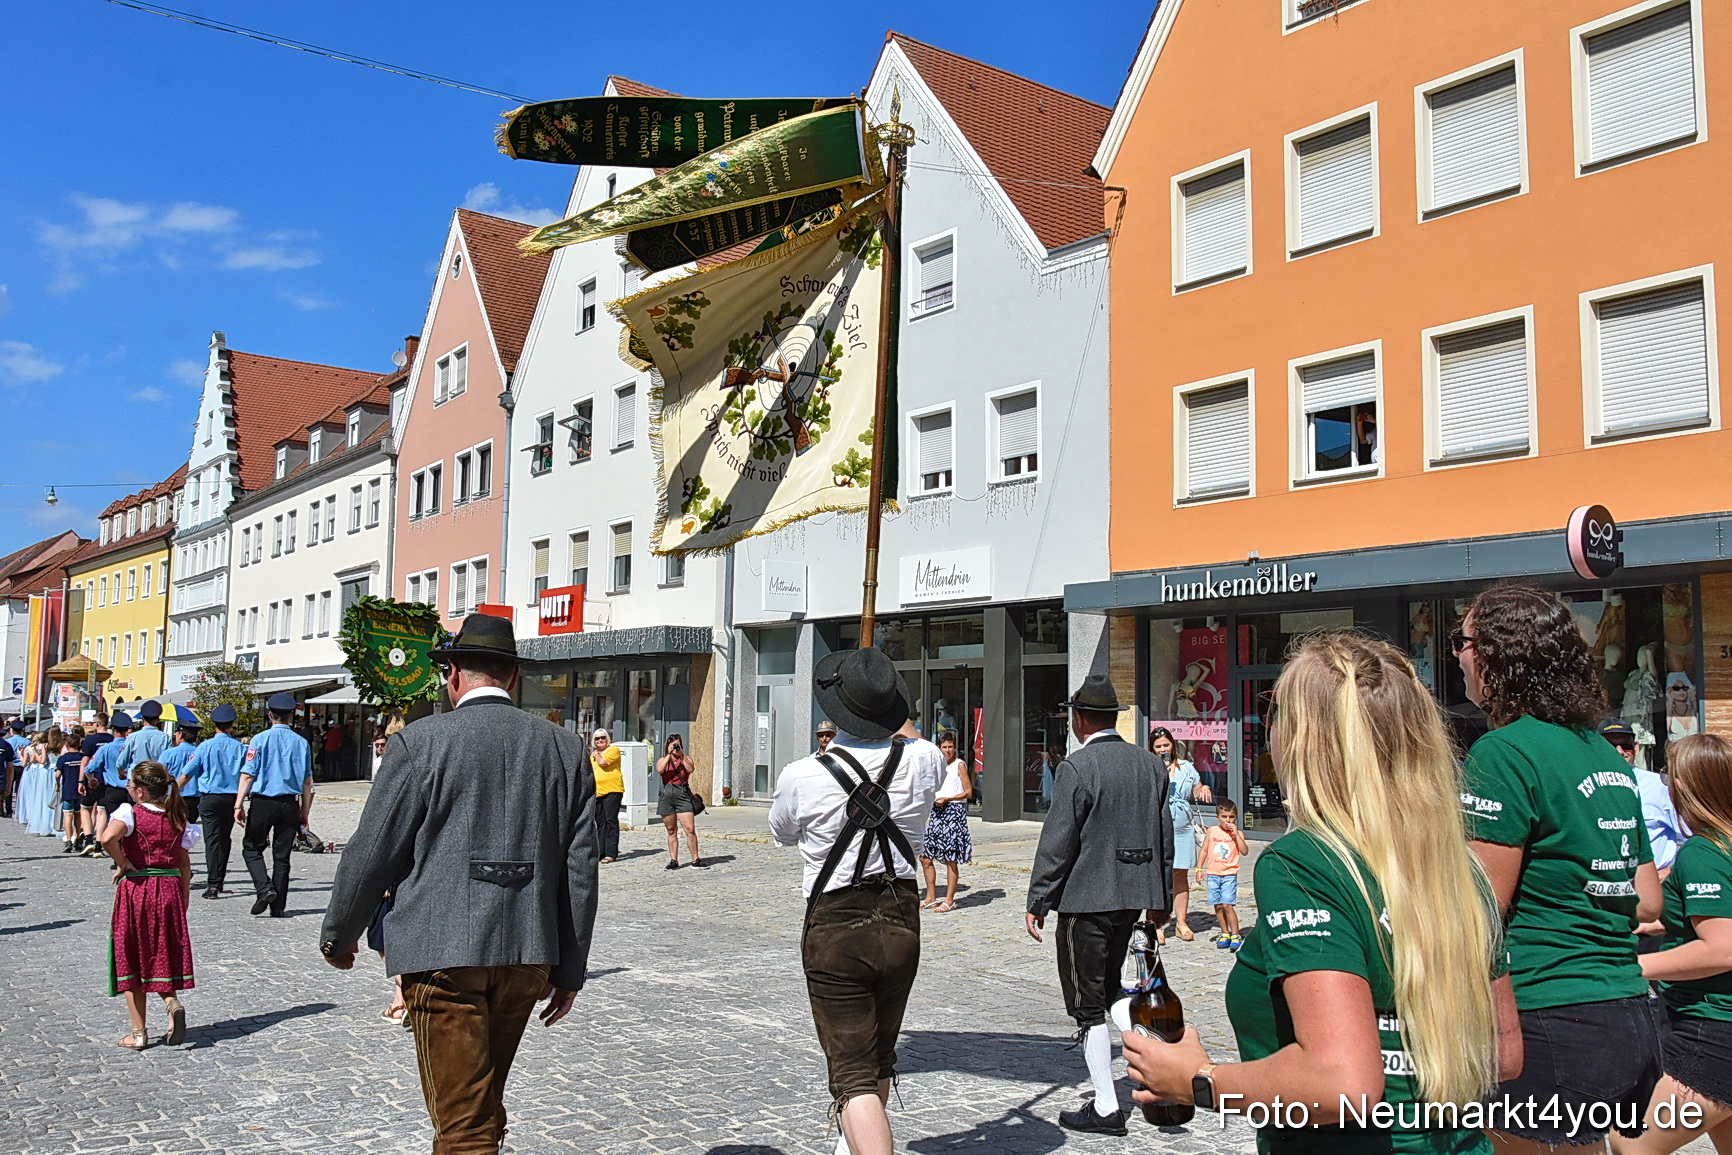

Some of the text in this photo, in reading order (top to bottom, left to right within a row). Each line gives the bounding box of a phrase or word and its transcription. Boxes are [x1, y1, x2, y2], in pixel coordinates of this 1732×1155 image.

[581, 119, 593, 142] 1902
[605, 104, 618, 160] Tannenreis
[674, 115, 684, 152] von der
[688, 219, 700, 241] 957
[700, 404, 787, 482] Sprich nicht viel.
[769, 576, 802, 592] Mittendrin
[915, 559, 971, 592] Mittendrin
[1161, 563, 1316, 602] hunkemöller
[541, 594, 571, 619] WITT
[373, 621, 426, 636] EICHENLAUB
[1192, 635, 1227, 646] BIG SE
[373, 665, 424, 686] PAVELSBACH
[1621, 834, 1630, 856] &
[1588, 883, 1634, 895] 30.06.-0
